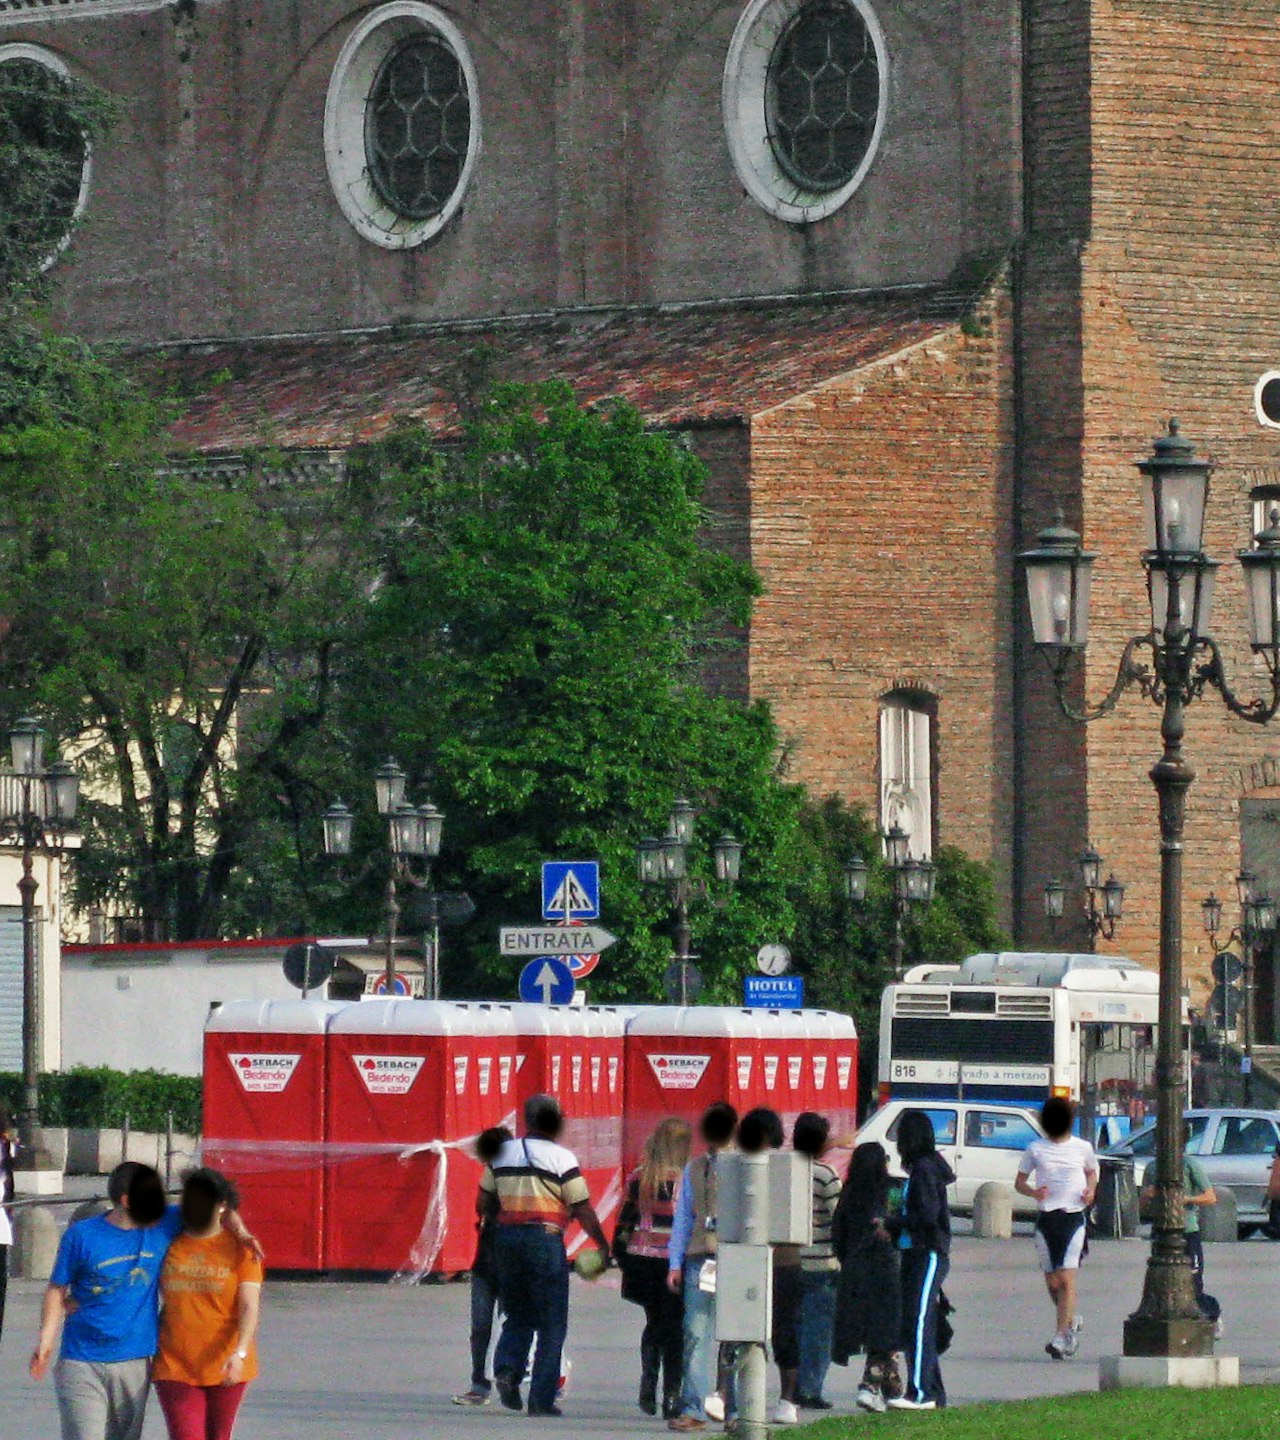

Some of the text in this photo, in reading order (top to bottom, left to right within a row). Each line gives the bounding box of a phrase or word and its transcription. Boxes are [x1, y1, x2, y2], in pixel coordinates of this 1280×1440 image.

[504, 932, 595, 949] ENTRATA
[749, 980, 797, 991] HOTEL
[252, 1059, 293, 1067] SEBACH
[376, 1061, 417, 1069] SEBACH
[668, 1059, 704, 1067] SEBACH
[243, 1070, 286, 1080] Bedendo
[660, 1070, 697, 1080] Bedendo
[895, 1065, 916, 1077] 816
[993, 1071, 1000, 1079] a
[1003, 1071, 1047, 1081] metano
[367, 1072, 410, 1083] Bedendo
